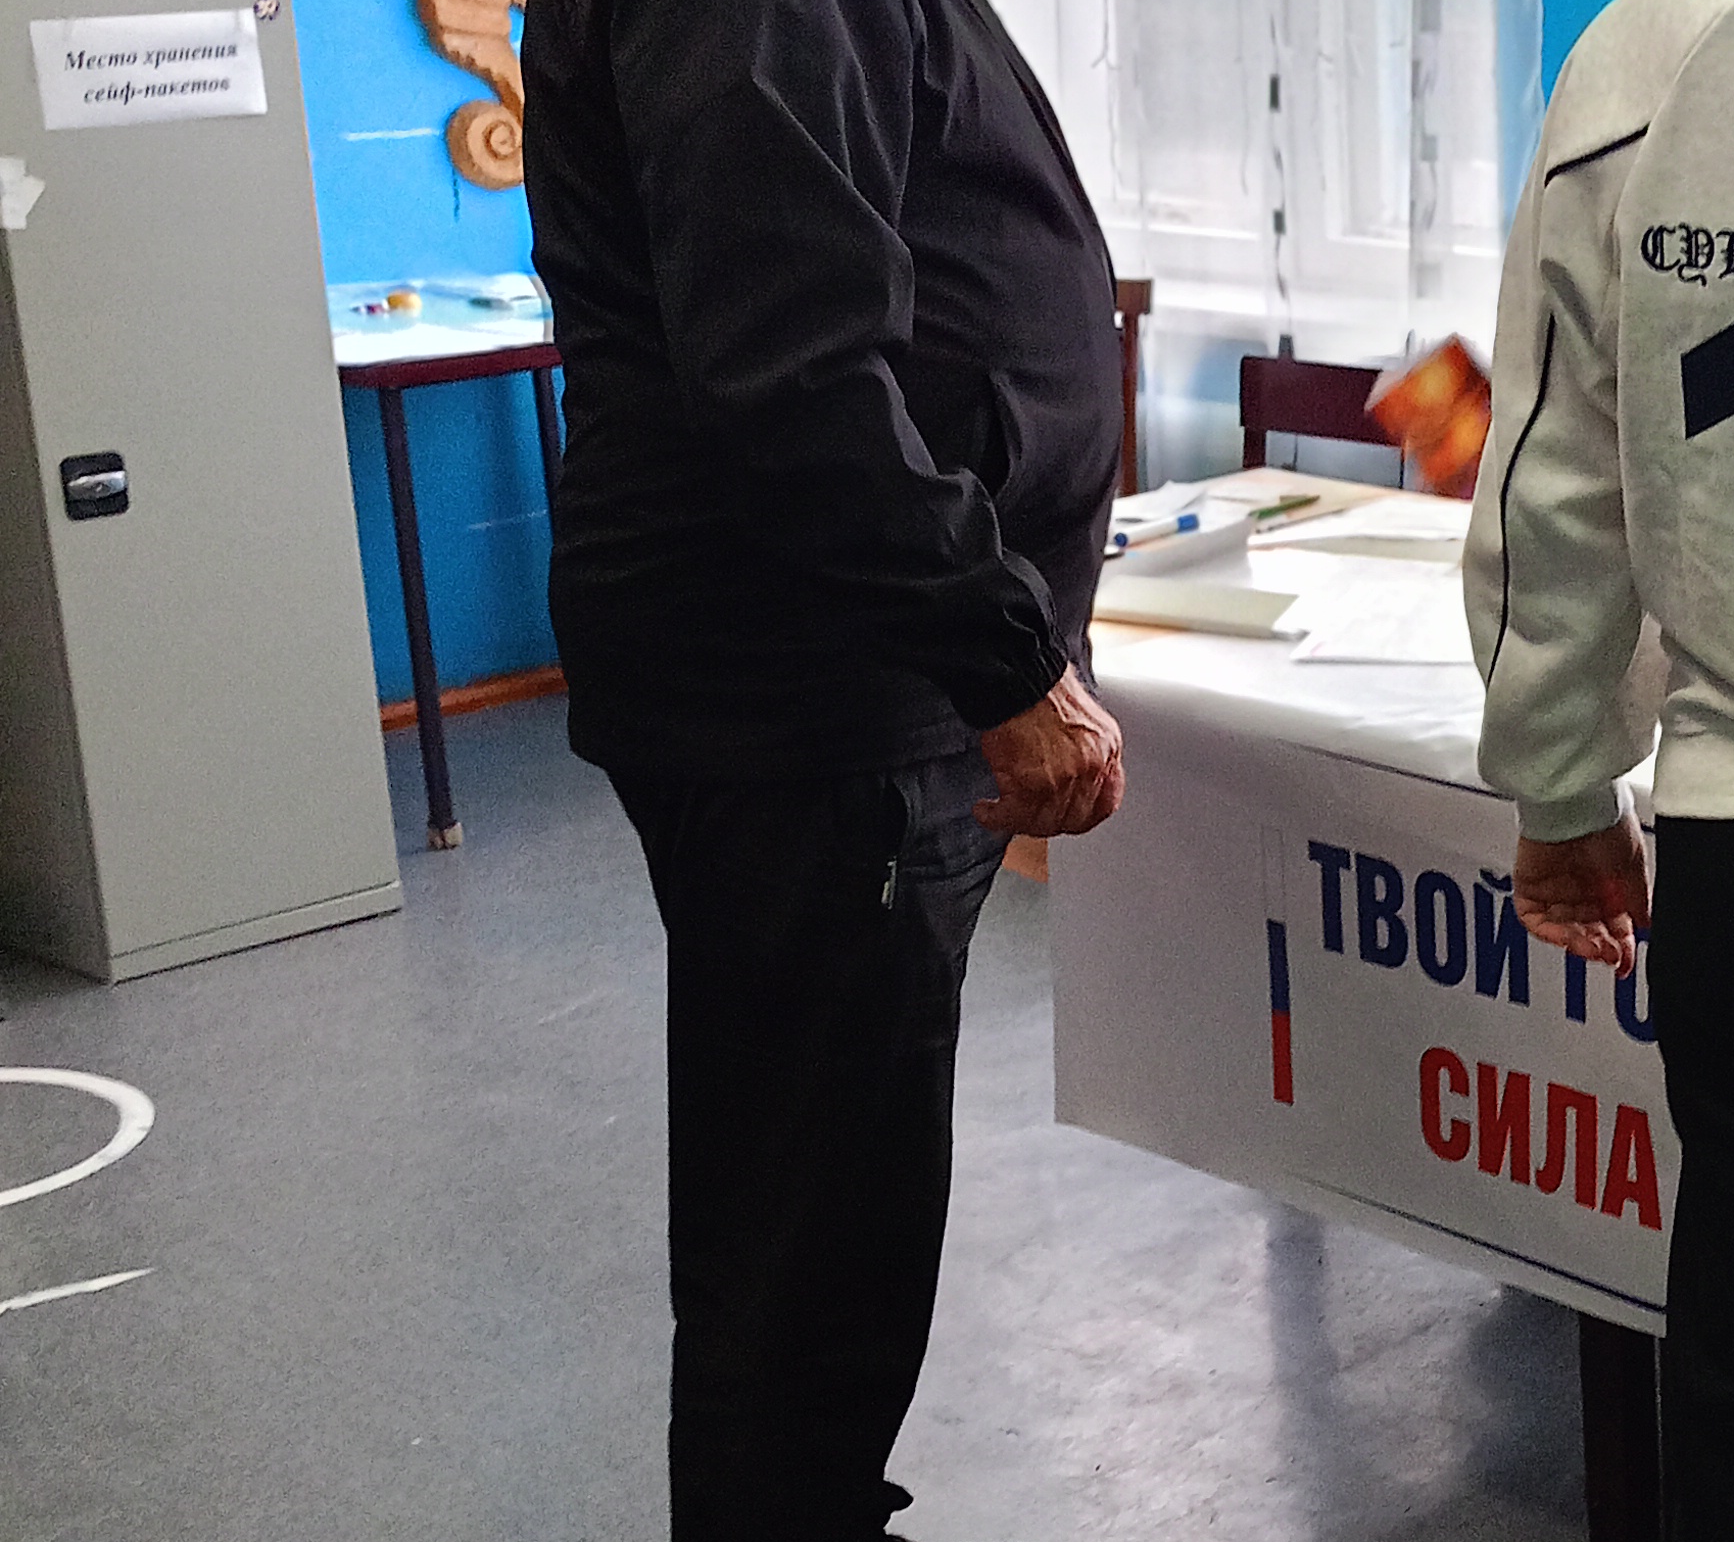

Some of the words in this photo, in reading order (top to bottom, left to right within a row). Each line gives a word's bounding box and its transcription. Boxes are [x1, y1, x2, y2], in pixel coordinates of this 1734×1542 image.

[64, 50, 138, 71] Место
[143, 43, 239, 69] хранения
[83, 76, 232, 106] сейф-пакетов
[1307, 840, 1531, 1008] ТВОЙ
[1418, 1046, 1663, 1231] СИЛА
